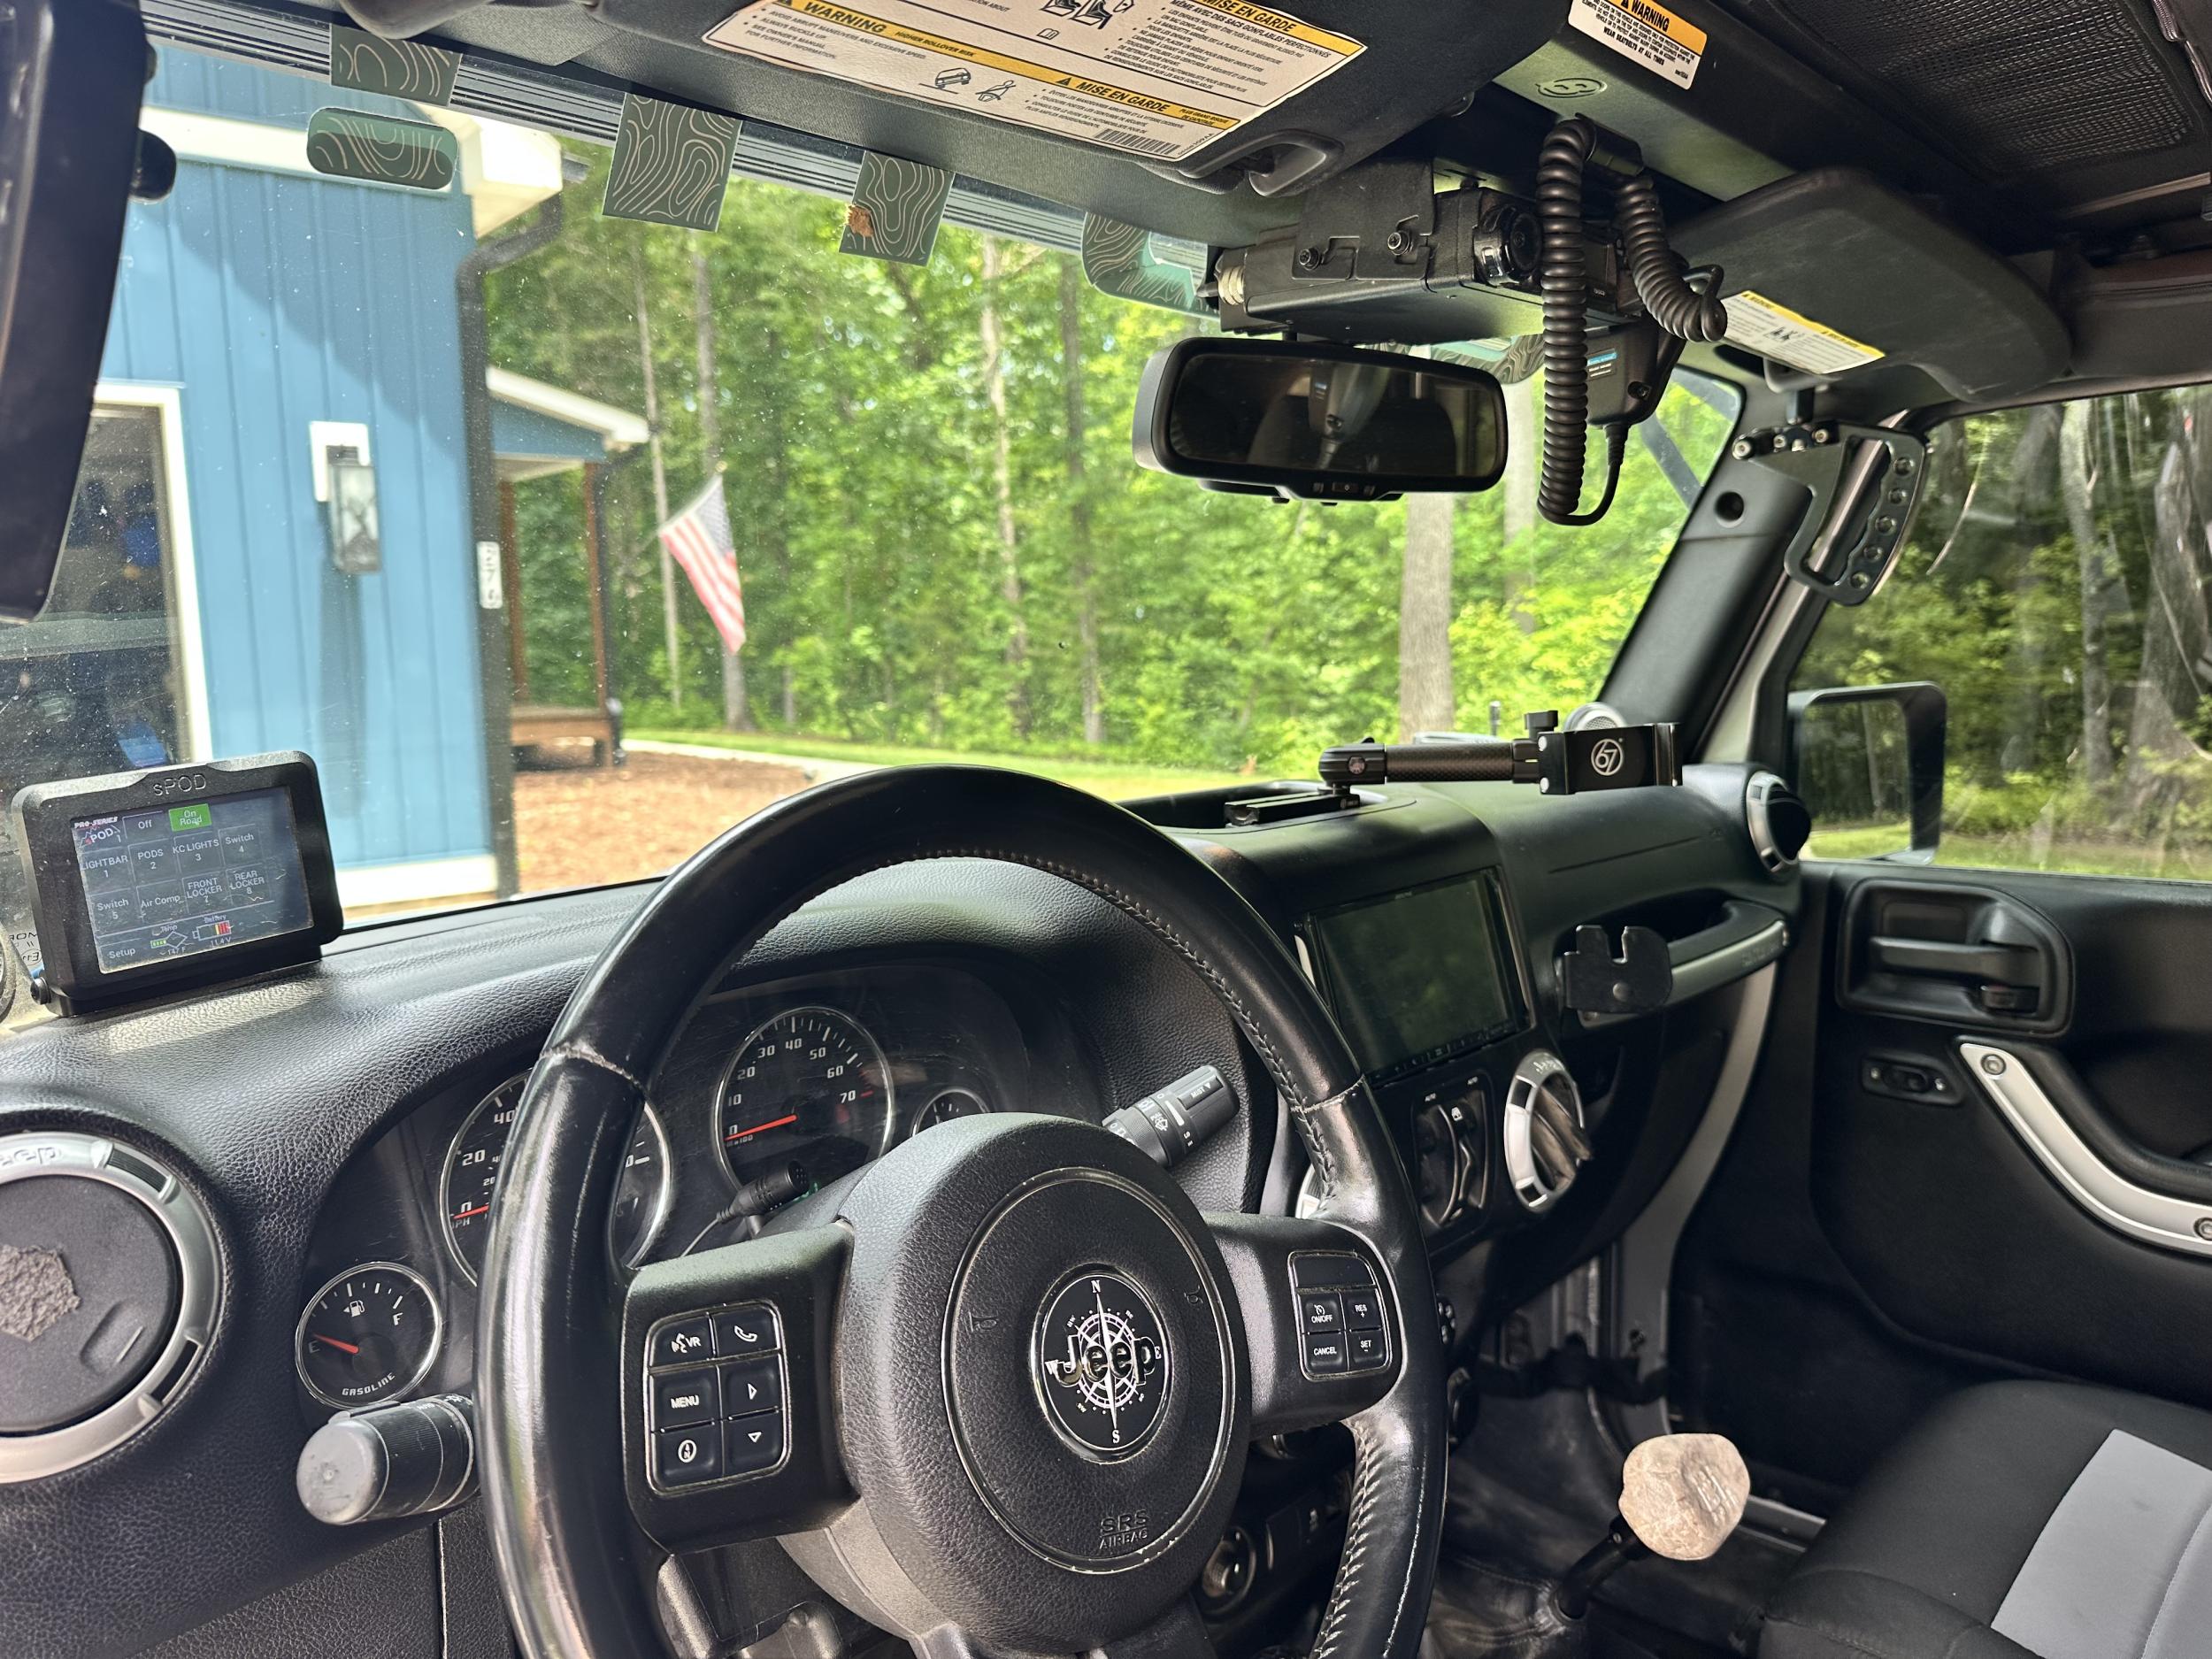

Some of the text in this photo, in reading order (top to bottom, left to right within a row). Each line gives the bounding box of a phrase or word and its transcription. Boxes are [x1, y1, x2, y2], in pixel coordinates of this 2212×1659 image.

[803, 3, 887, 34] WARNING
[1193, 4, 1212, 17] AVEC
[1211, 12, 1227, 22] DES
[1225, 19, 1245, 28] SACS
[1234, 5, 1257, 19] EN
[1254, 11, 1297, 33] GARDE
[1632, 0, 1670, 32] WARNING
[895, 31, 976, 58] HIGHER ROLLOVER RISK
[1075, 81, 1171, 112] MISE EN GARDE
[1594, 740, 1619, 775] 67
[153, 772, 207, 796] sPOD
[74, 816, 118, 829] PRO-SERIES
[137, 819, 152, 830] Off
[179, 815, 203, 826] Road
[226, 833, 255, 845] Switch
[173, 839, 220, 855] KC LIGHTS
[137, 849, 164, 861] PODS
[195, 853, 202, 862] 3
[80, 855, 128, 871] LIGHTBAR
[150, 861, 157, 870] 2
[234, 870, 257, 881] REAR
[188, 877, 218, 890] FRONT
[230, 877, 265, 890] LOCKER
[187, 885, 222, 899] LOCKER
[96, 897, 129, 910] Switch
[140, 895, 181, 909] Air Comp
[108, 947, 136, 960] Setup
[785, 1038, 803, 1050] 40
[757, 1045, 775, 1059] 30
[809, 1047, 826, 1060] 50
[737, 1066, 756, 1080] 20
[826, 1065, 843, 1079] 60
[840, 1090, 856, 1104] 70
[1190, 1087, 1206, 1099] MIST
[728, 1094, 741, 1107] 10
[494, 1110, 515, 1125] 40
[462, 1149, 486, 1166] 20
[1091, 1279, 1102, 1294] N
[1355, 1304, 1368, 1313] RES
[392, 1312, 403, 1325] F
[1311, 1314, 1333, 1324] ON/OFF
[308, 1340, 320, 1354] E
[687, 1336, 702, 1348] VR
[1360, 1340, 1371, 1348] SET
[1154, 1346, 1162, 1360] E
[1313, 1347, 1337, 1356] CANCEL
[1054, 1334, 1156, 1387] Jeep
[342, 1371, 396, 1396] GASOLINE
[671, 1394, 700, 1409] MENU
[1111, 1430, 1120, 1443] S
[1100, 1509, 1149, 1533] SRS
[1099, 1527, 1148, 1549] AIRBAG
